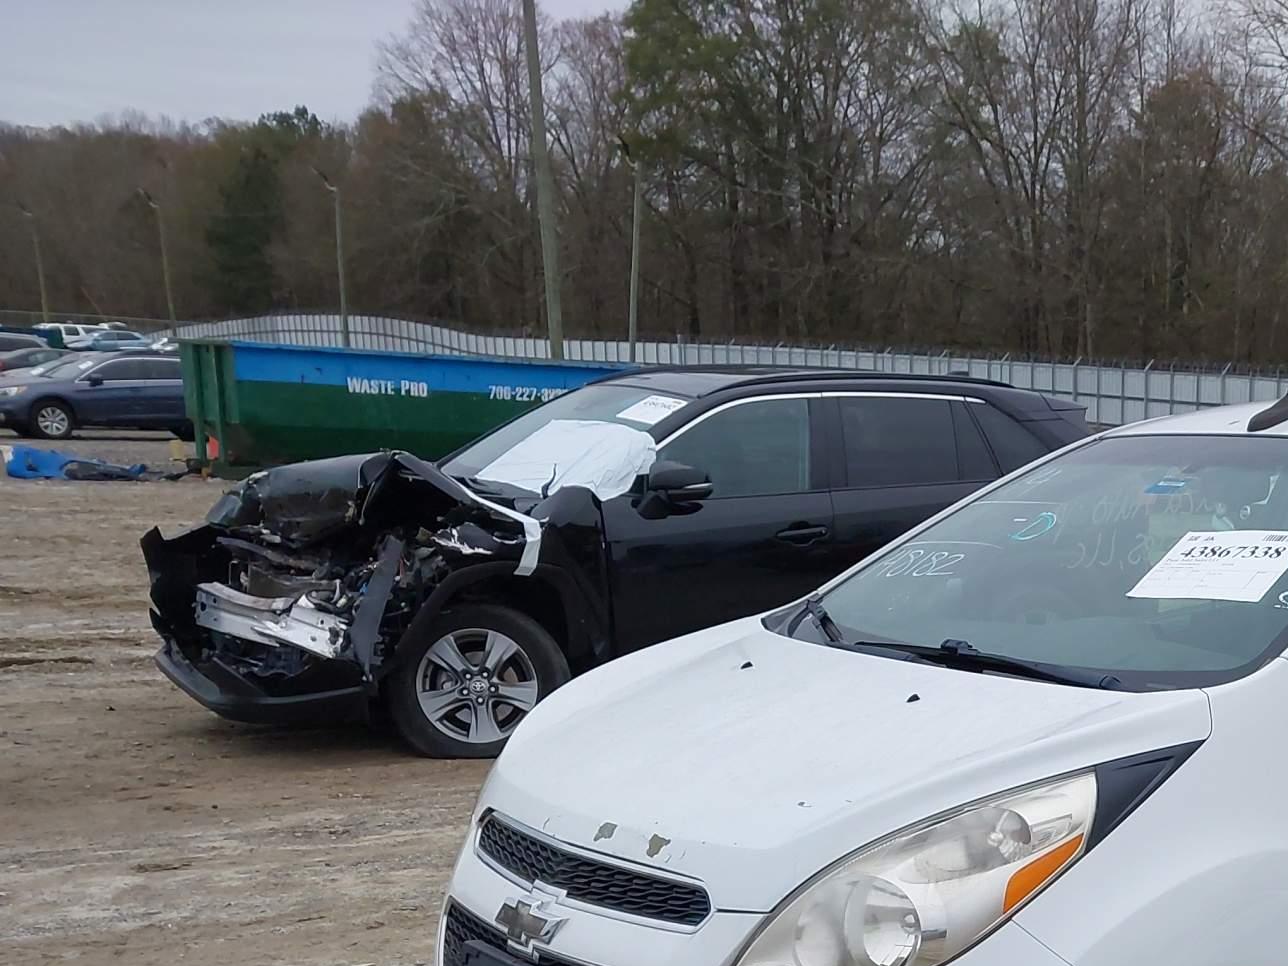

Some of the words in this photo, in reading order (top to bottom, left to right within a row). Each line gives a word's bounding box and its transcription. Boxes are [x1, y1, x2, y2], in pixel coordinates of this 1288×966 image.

[347, 376, 395, 395] WASTE
[401, 379, 428, 397] PRO
[489, 385, 569, 402] 706-227-3
[1180, 545, 1288, 561] 43867338
